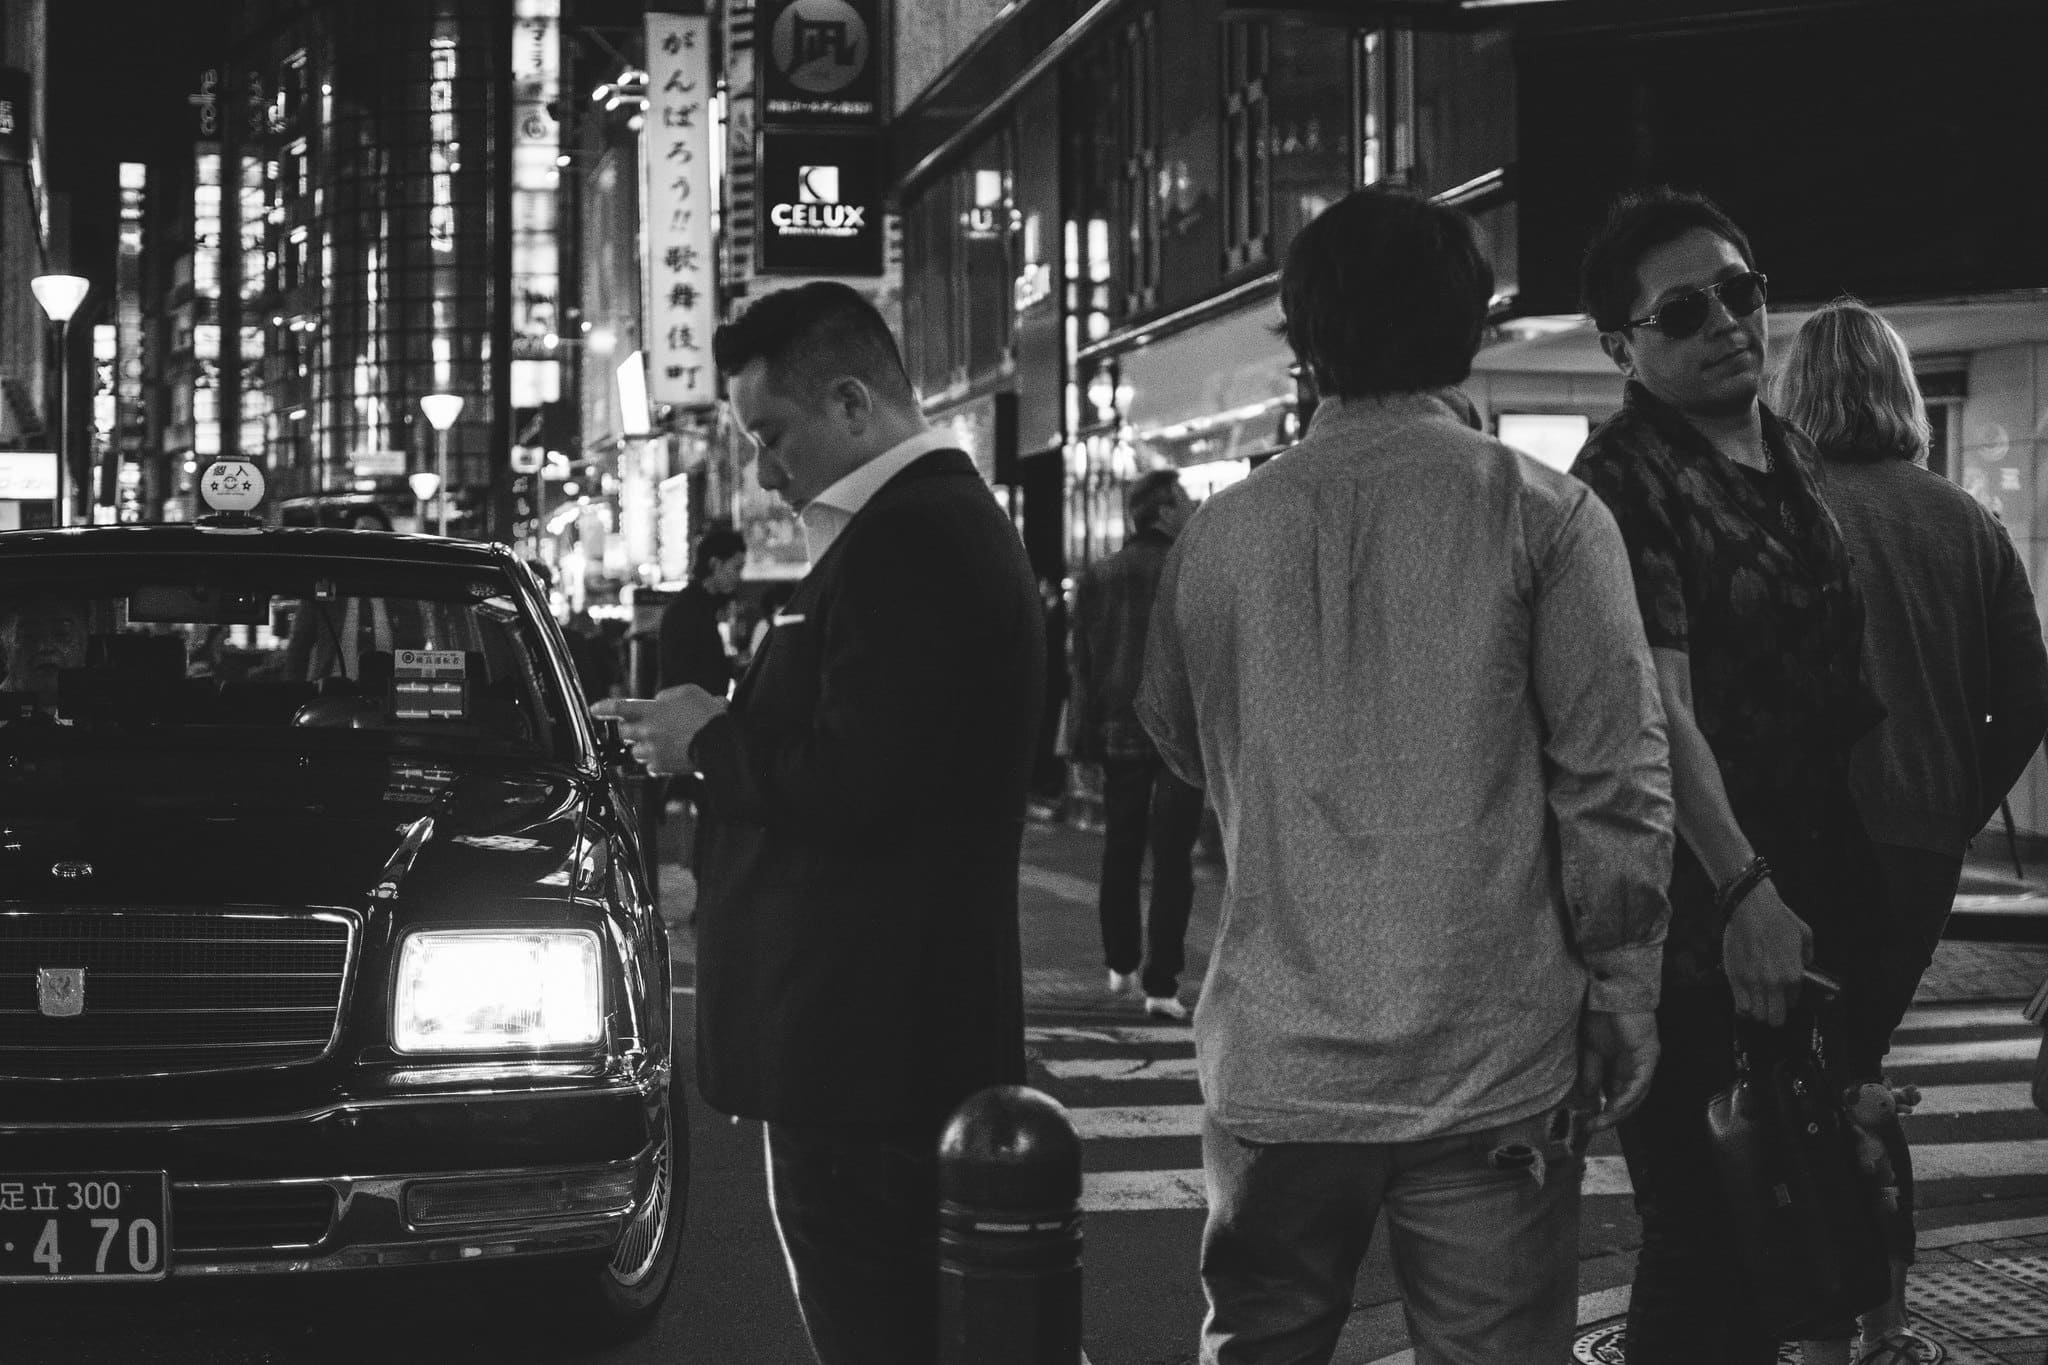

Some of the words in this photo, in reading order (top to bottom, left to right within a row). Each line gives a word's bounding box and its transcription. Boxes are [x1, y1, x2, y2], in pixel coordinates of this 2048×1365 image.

[770, 203, 865, 228] CELUX
[0, 1182, 60, 1211] 足立
[67, 1182, 121, 1210] 300
